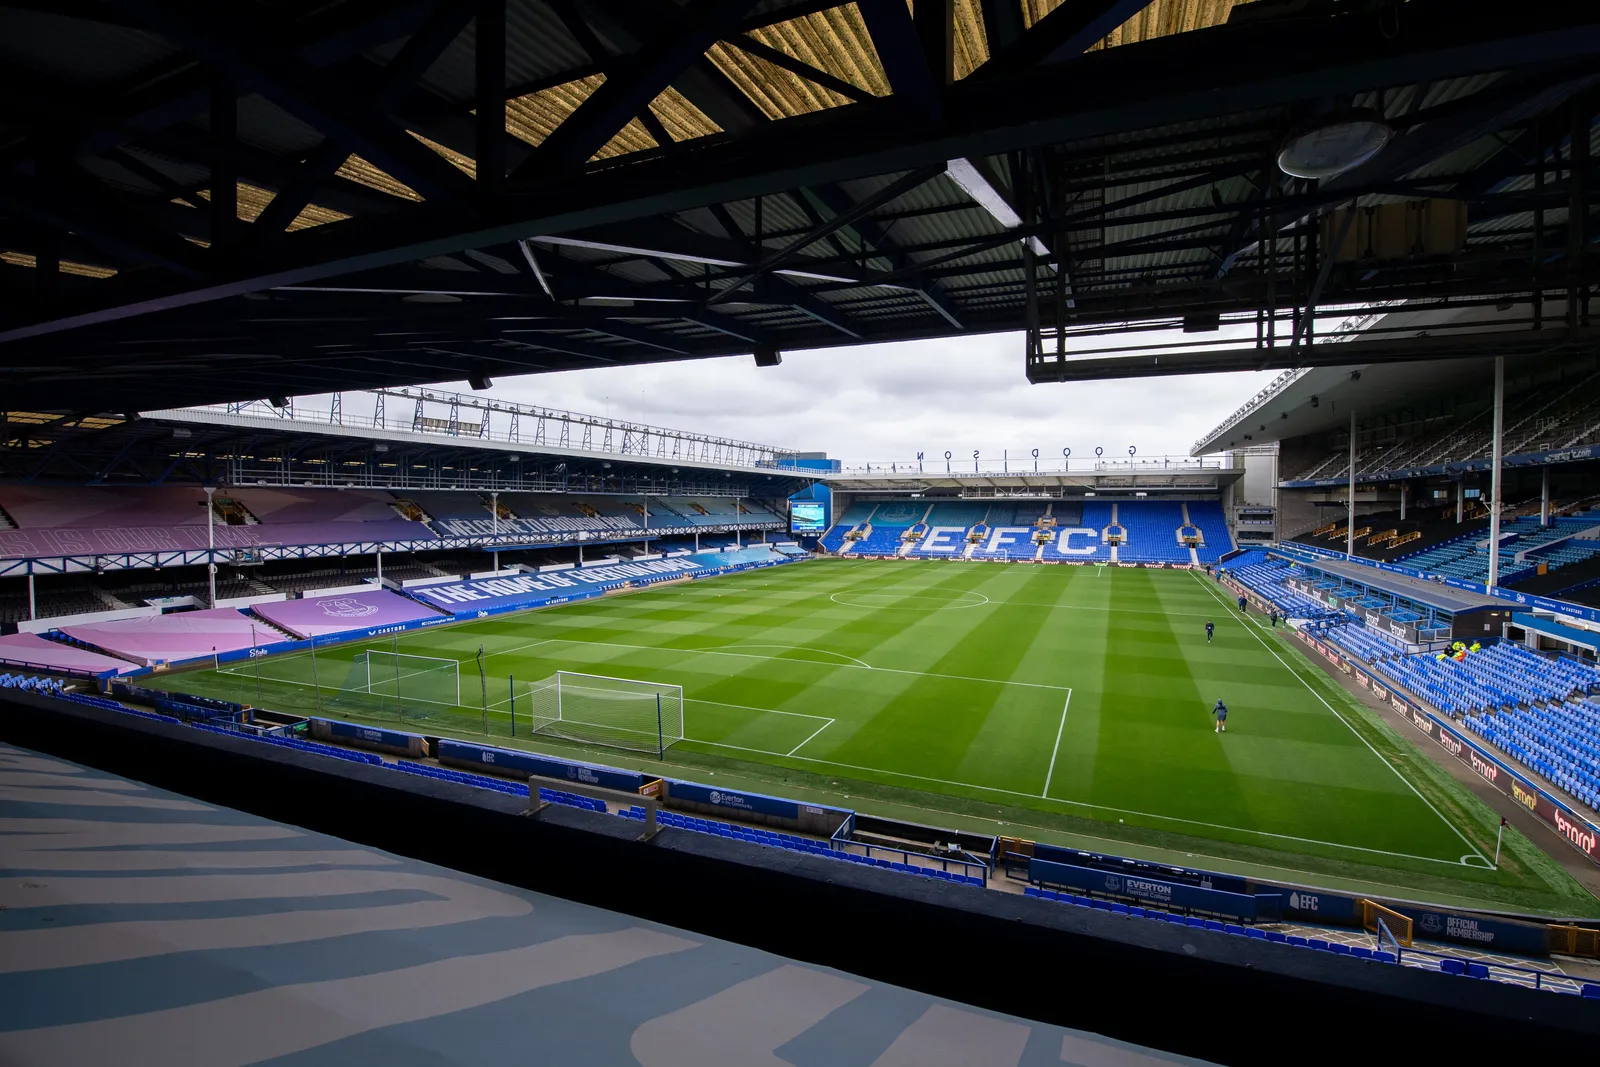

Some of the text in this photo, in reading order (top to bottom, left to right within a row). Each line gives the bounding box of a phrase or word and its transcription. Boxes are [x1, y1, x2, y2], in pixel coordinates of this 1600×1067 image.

[438, 518, 528, 536] WELCOME
[517, 518, 548, 533] TO
[600, 515, 641, 530] PARK
[39, 529, 94, 555] IS
[92, 526, 182, 551] OUR
[174, 525, 261, 549] TIME
[920, 526, 1099, 556] EFC
[413, 584, 492, 604] THE
[469, 575, 547, 597] HOME
[537, 572, 579, 591] OF
[563, 562, 656, 583] EVERTON
[378, 625, 406, 635] CASTORE
[721, 793, 744, 804] Everton
[732, 801, 753, 810] Community
[1127, 879, 1172, 894] EVERTON
[1126, 888, 1171, 902] Football College
[1300, 894, 1319, 911] EFC
[1447, 916, 1479, 931] OFFICIAL
[1446, 926, 1495, 942] MEMBERSHIP
